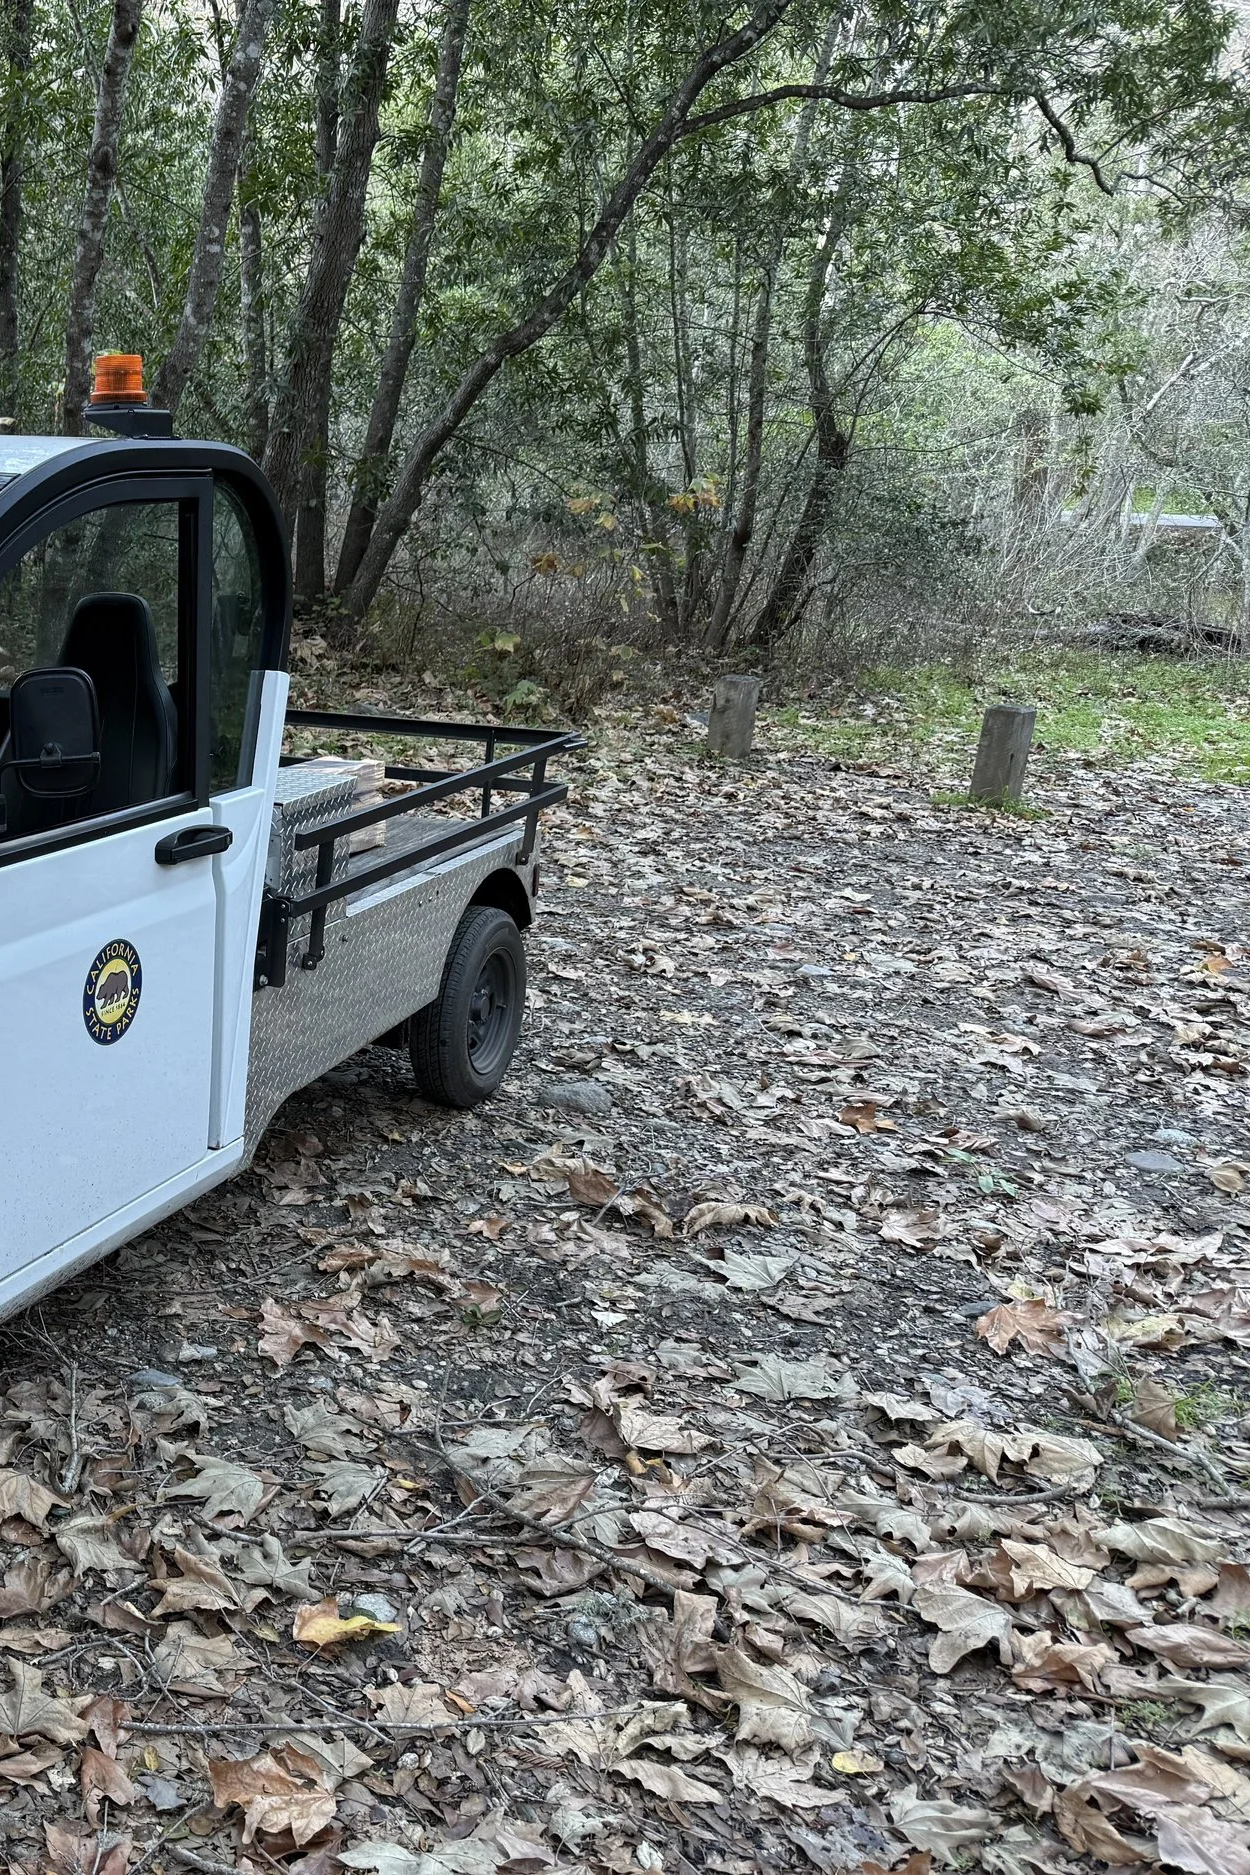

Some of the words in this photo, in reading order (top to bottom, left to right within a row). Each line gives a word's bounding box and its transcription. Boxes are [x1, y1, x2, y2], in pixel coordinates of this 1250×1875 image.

[86, 942, 139, 995] CALIFORNIA
[86, 1007, 112, 1040] STATE
[116, 987, 140, 1035] PARKS
